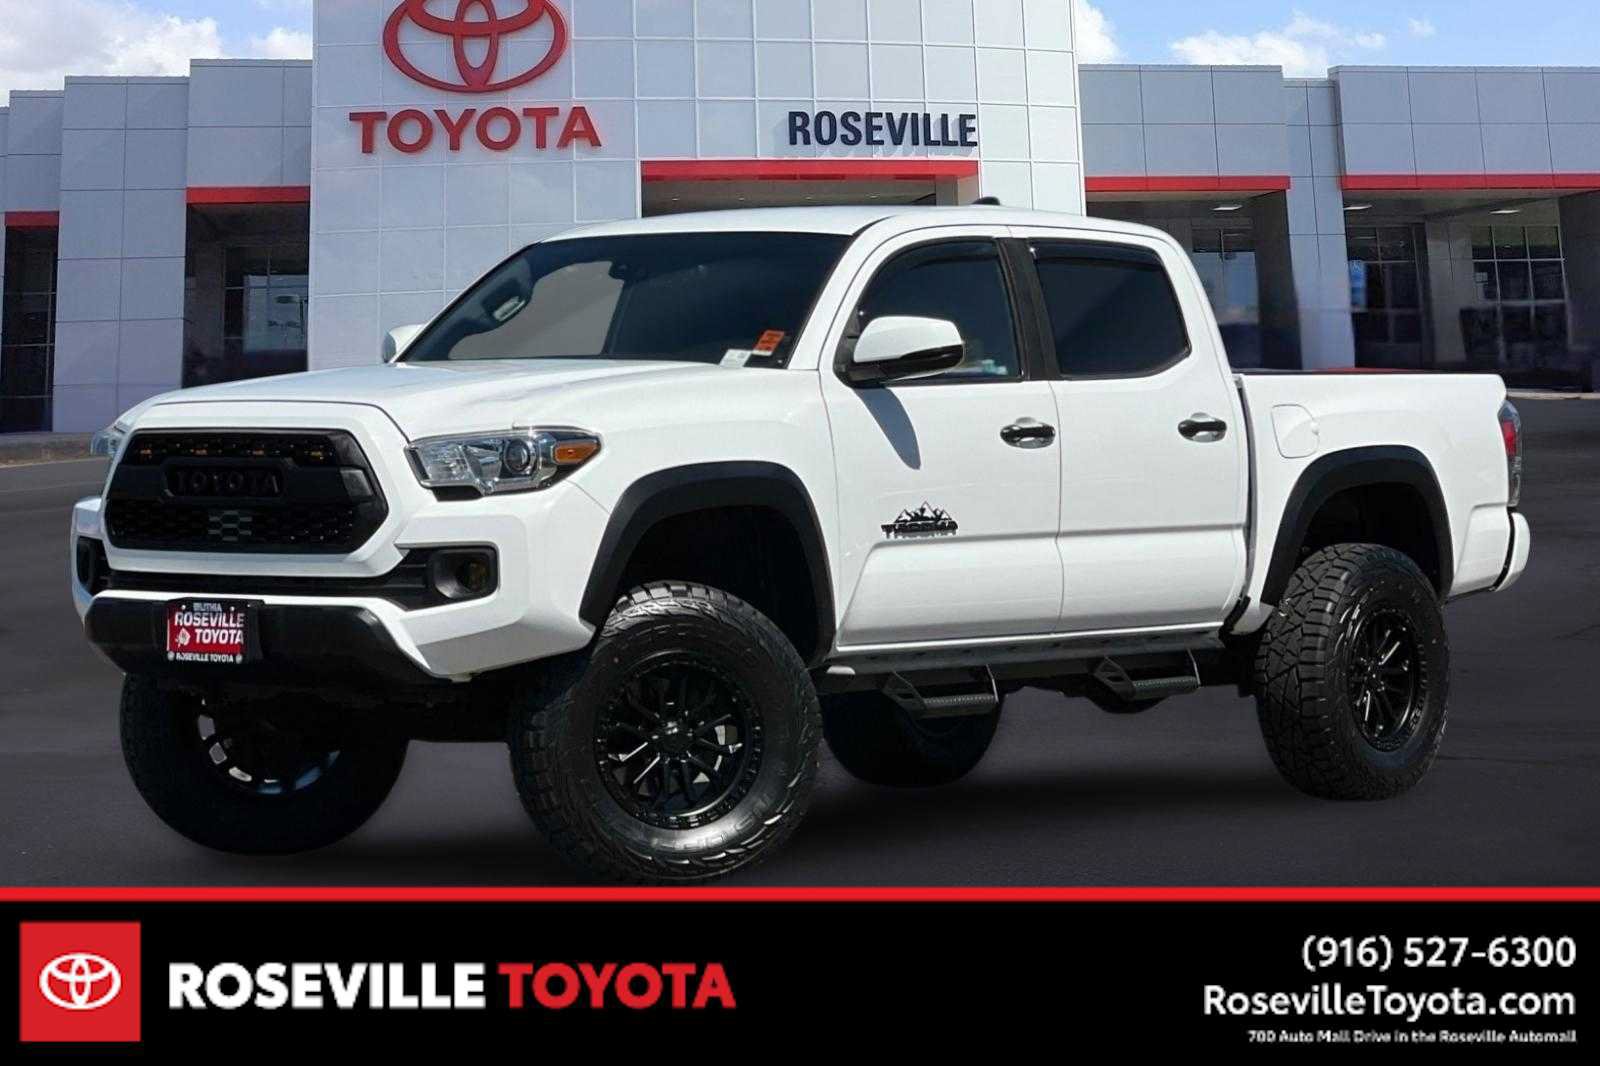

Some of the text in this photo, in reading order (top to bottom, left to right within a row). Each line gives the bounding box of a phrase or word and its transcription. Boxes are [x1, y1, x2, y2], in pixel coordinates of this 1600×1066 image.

[349, 106, 602, 154] TOYOTA
[788, 111, 978, 147] ROSEVILLE
[175, 469, 281, 495] TOYOTA
[174, 612, 245, 628] ROSEVILLE
[194, 628, 244, 645] TOYOTA
[176, 652, 234, 663] ROSEVILLE TOYOTA
